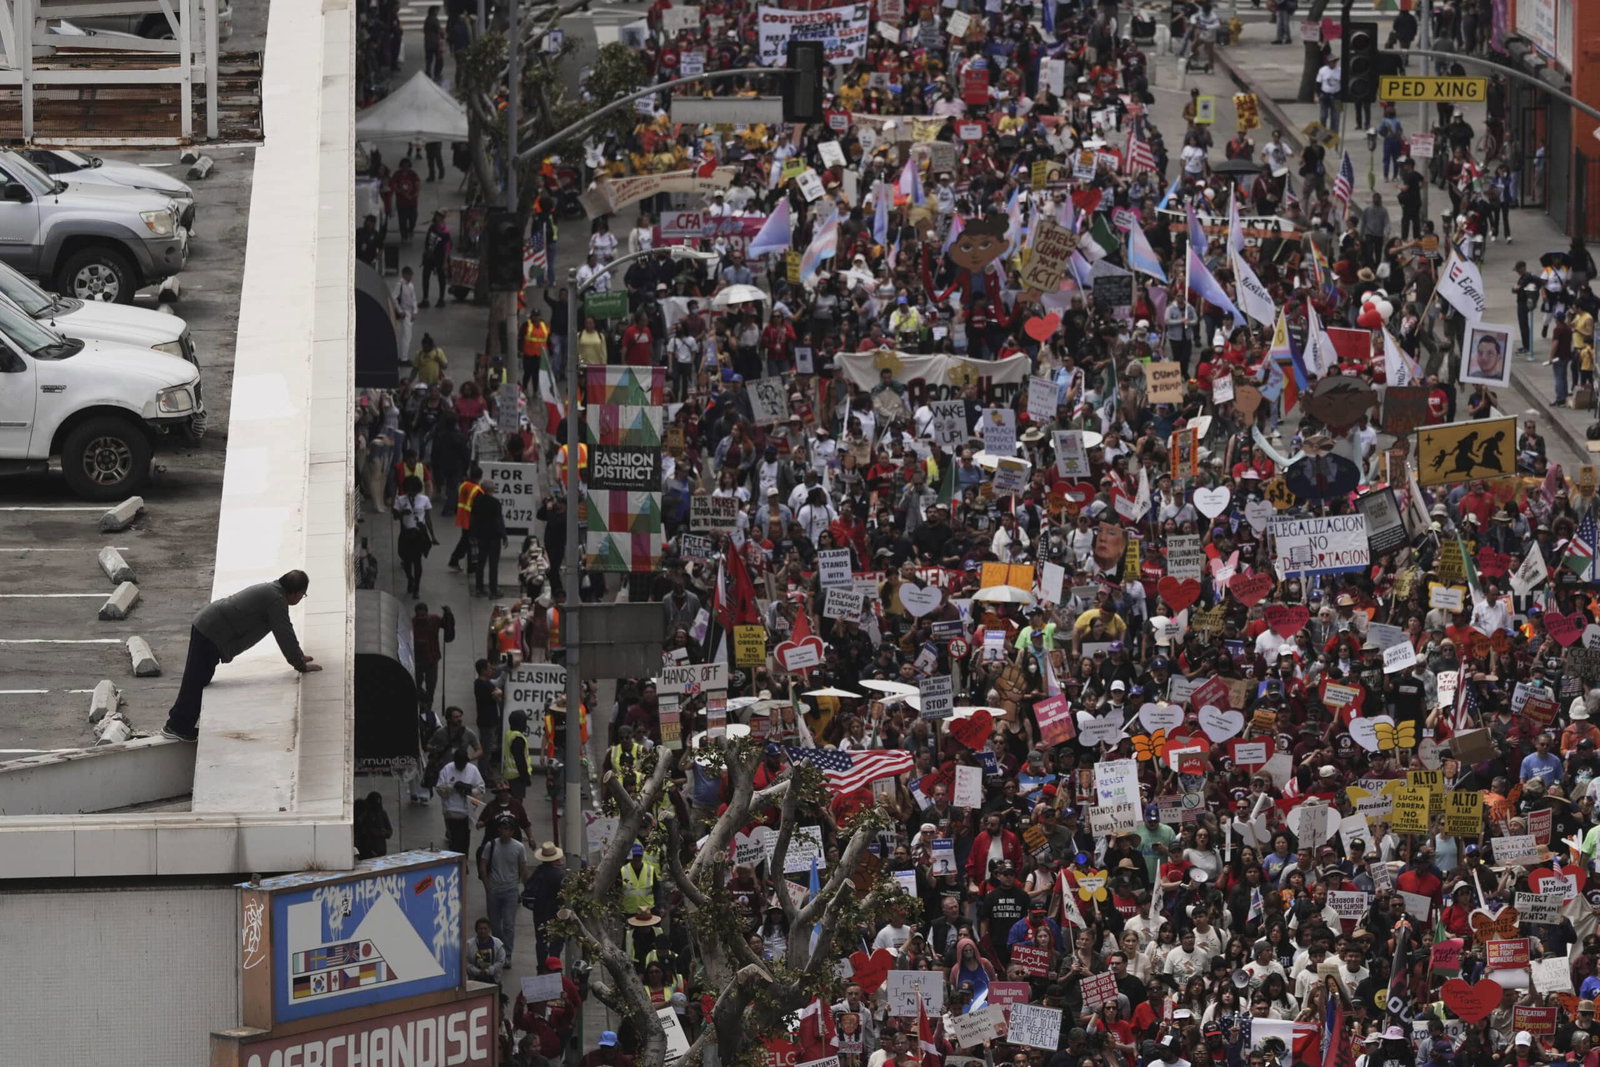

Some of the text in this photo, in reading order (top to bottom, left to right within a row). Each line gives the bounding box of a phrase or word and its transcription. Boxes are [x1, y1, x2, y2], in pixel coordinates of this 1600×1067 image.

[1388, 82, 1477, 97] PED XING
[676, 213, 700, 230] CFA
[1457, 276, 1486, 312] Equity
[1153, 370, 1180, 380] DUMP
[931, 405, 965, 419] WAKE
[942, 430, 962, 443] UP!
[594, 451, 654, 466] FASHION
[491, 469, 522, 481] FOR
[594, 466, 654, 480] DISTRICT
[494, 483, 533, 495] EASE
[501, 498, 515, 506] 213)
[1274, 517, 1364, 538] LEGALIZACION
[1169, 538, 1199, 548] STOP THE
[1309, 536, 1328, 550] NO
[828, 551, 849, 559] LABOR
[1283, 549, 1370, 571] DORTACION
[821, 561, 848, 569] STANDS
[1169, 558, 1199, 566] TAKEOVER
[829, 591, 860, 604] DEVOUR
[509, 671, 567, 685] LEASING
[664, 665, 721, 685] HANDS OFF
[685, 682, 701, 695] US
[926, 699, 948, 711] STOP
[1183, 759, 1200, 768] MAGA
[1099, 776, 1124, 786] RESIST
[1413, 772, 1438, 785] ALTO
[1359, 781, 1383, 791] WOR
[1358, 800, 1392, 811] Resiste!
[1452, 793, 1478, 807] ALTO
[1091, 803, 1132, 817] HANDS OFF
[1094, 819, 1134, 832] EDUCATION
[1530, 822, 1551, 831] TRANS
[1521, 841, 1535, 849] ALL
[737, 846, 764, 857] Belong
[1495, 848, 1538, 861] IMMIGRANTS
[1543, 884, 1572, 893] Belong
[1517, 893, 1548, 903] PROTECT
[1116, 904, 1137, 913] NITE
[1531, 904, 1556, 913] HUMAN
[1519, 912, 1548, 920] IGHTS!
[1013, 945, 1049, 957] FUND CARE
[902, 974, 928, 990] Fight
[1083, 977, 1110, 990] SOME CUTS
[1101, 983, 1114, 992] HEAL
[993, 988, 1008, 996] Fund
[906, 998, 931, 1006] NT
[1012, 1003, 1023, 1014] ALL
[1515, 1009, 1547, 1017] EDUCATION
[1011, 1014, 1039, 1028] DESERVE
[1514, 1022, 1553, 1030] DEPORTATION
[1010, 1022, 1053, 1037] WITH RESPECT
[247, 1007, 488, 1067] CHANDISE
[1010, 1031, 1057, 1047] AND HEALTH
